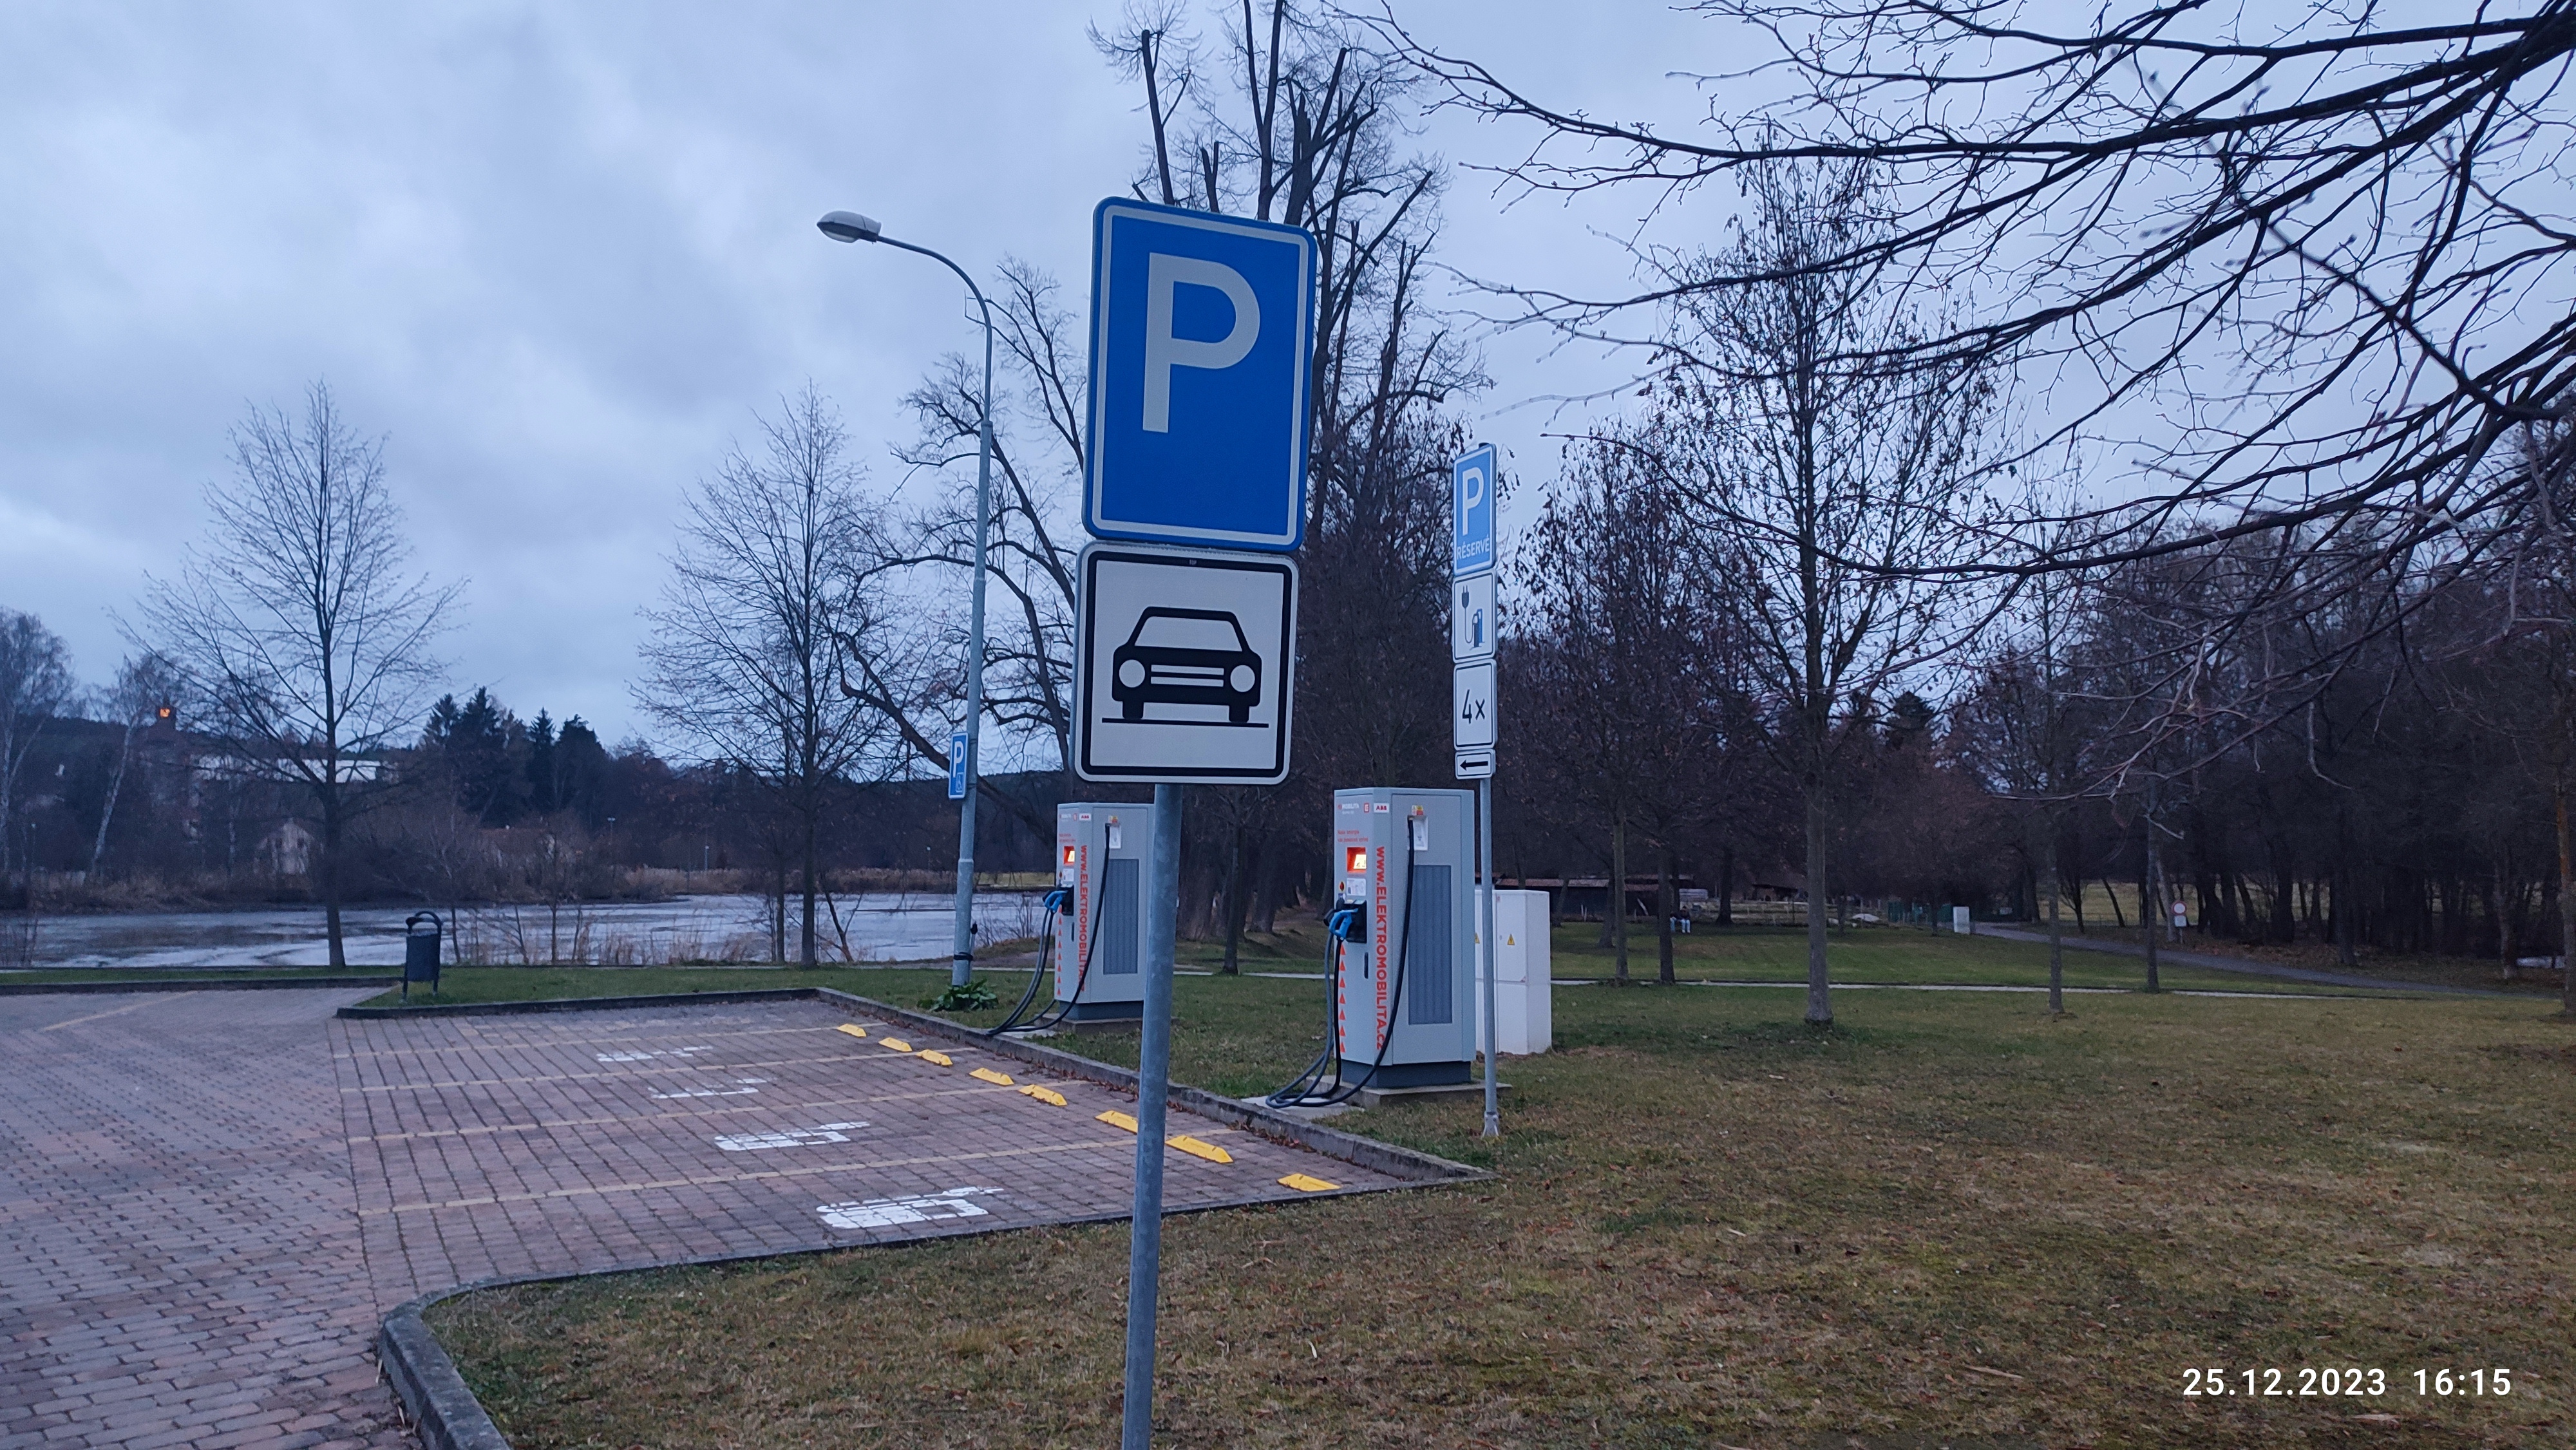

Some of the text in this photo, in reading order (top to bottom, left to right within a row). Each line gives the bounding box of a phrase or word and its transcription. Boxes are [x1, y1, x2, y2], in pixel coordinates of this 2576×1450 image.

[1143, 252, 1260, 433] P
[1462, 467, 1484, 536] P
[1457, 533, 1490, 560] RÉSERVÉ
[953, 740, 964, 778] P
